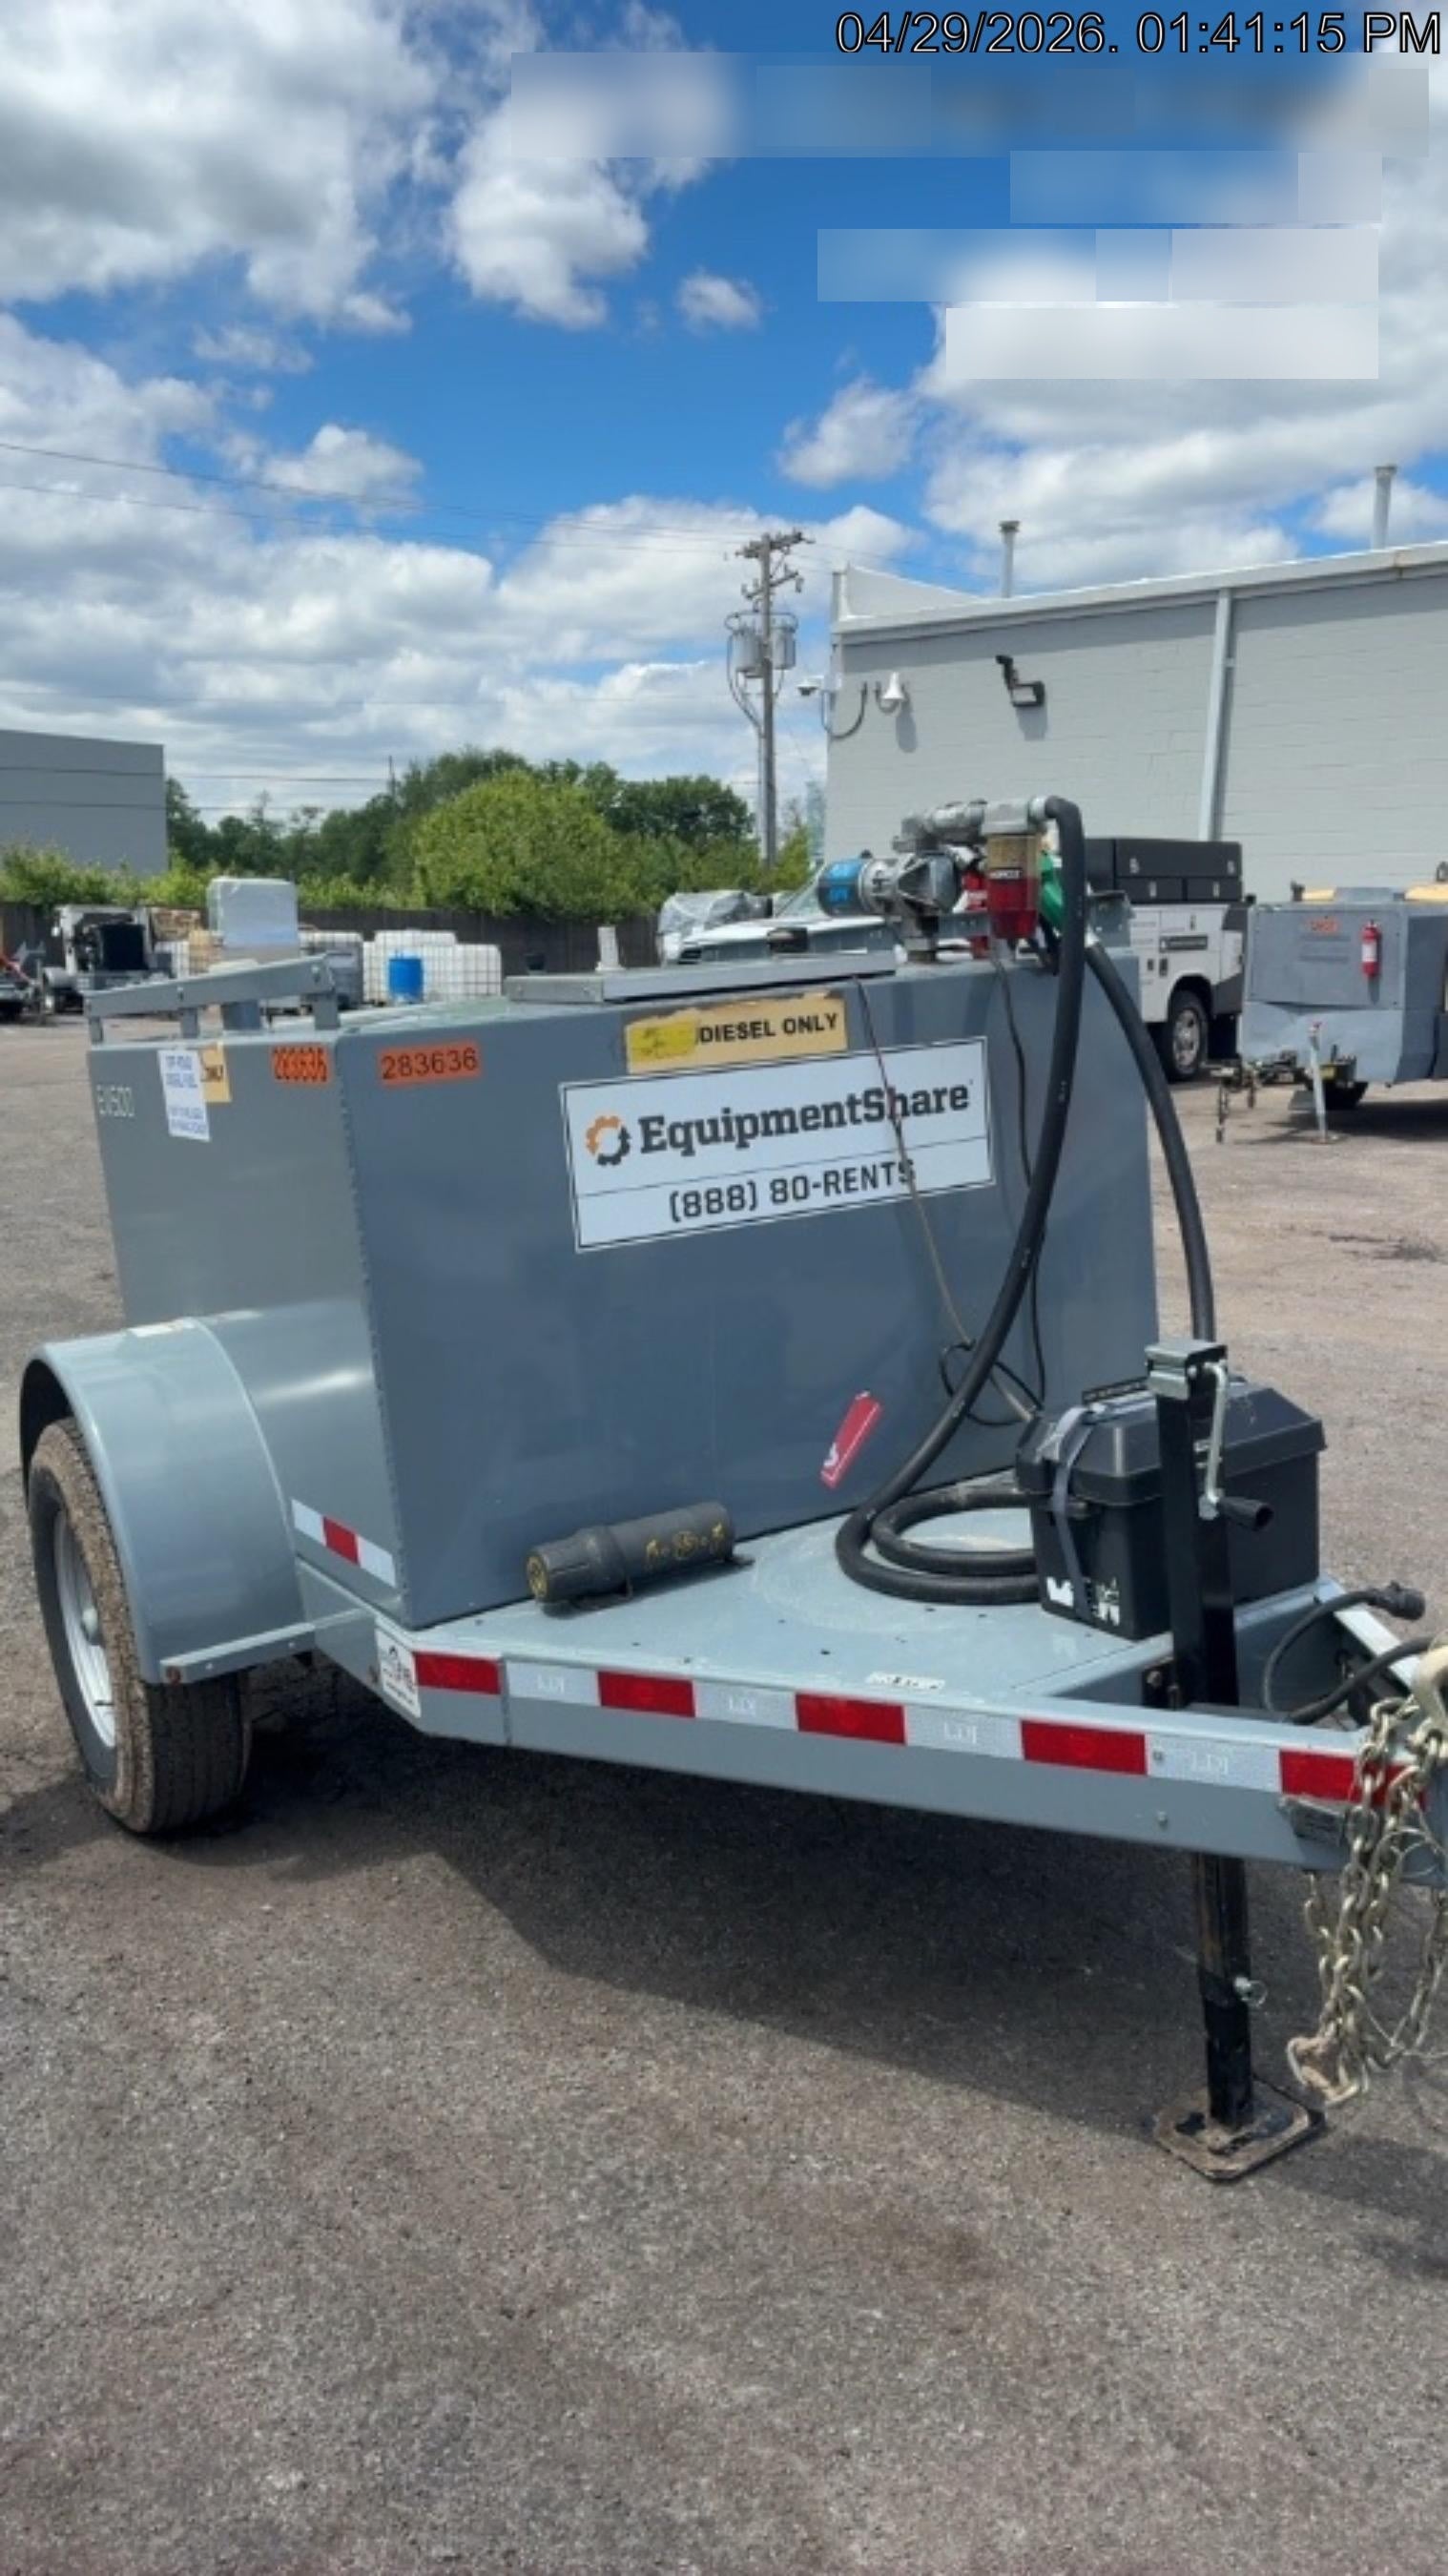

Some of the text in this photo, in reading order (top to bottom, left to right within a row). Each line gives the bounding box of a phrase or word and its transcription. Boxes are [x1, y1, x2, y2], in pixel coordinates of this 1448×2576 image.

[699, 1020, 776, 1044] DIESEL
[782, 1013, 838, 1035] ONLY
[382, 1047, 478, 1079] 283636
[638, 1083, 970, 1156] EquipmentShare
[669, 1158, 915, 1222] (888) 80-RENTS
